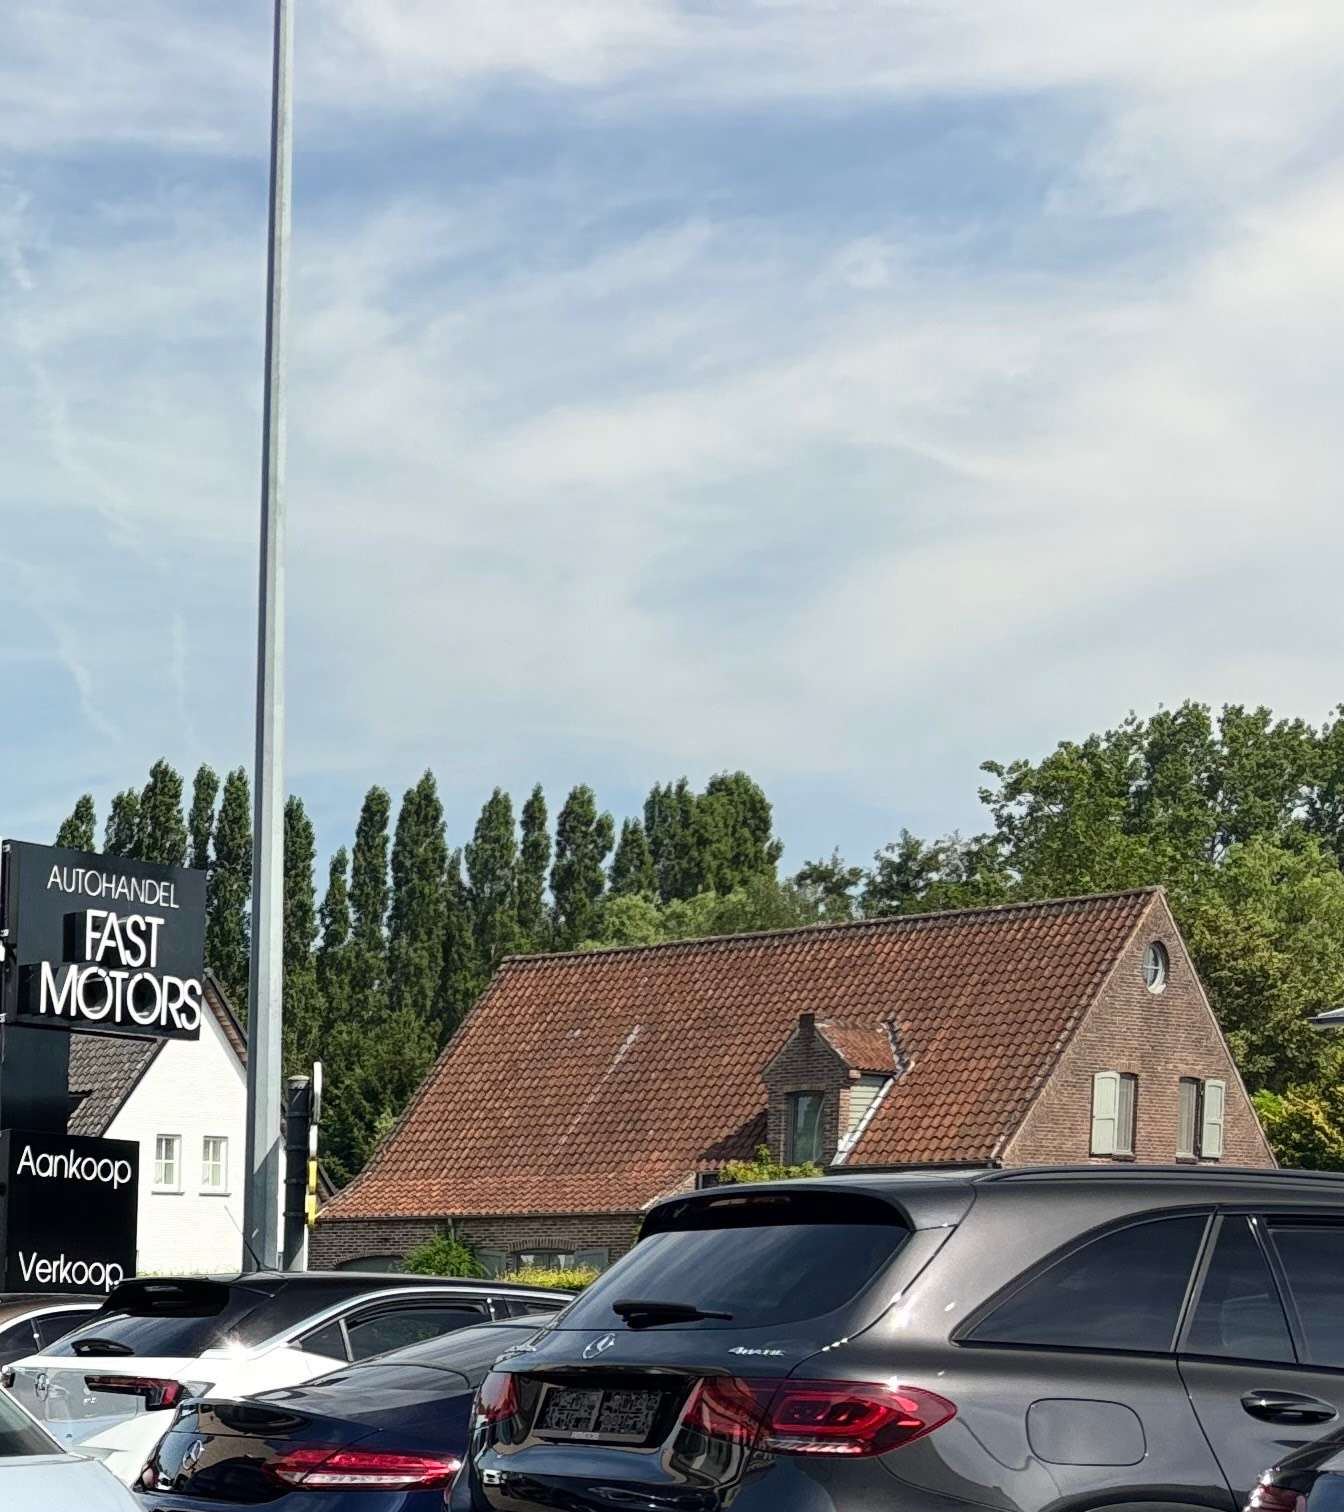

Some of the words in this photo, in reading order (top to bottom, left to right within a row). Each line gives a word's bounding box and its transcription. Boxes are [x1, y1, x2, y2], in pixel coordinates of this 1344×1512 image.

[47, 864, 180, 909] AUTOHANDEL
[84, 908, 165, 968] FAST
[40, 961, 202, 1031] MOTORS
[17, 1145, 132, 1187] Aankoop
[18, 1252, 124, 1291] Verkoop
